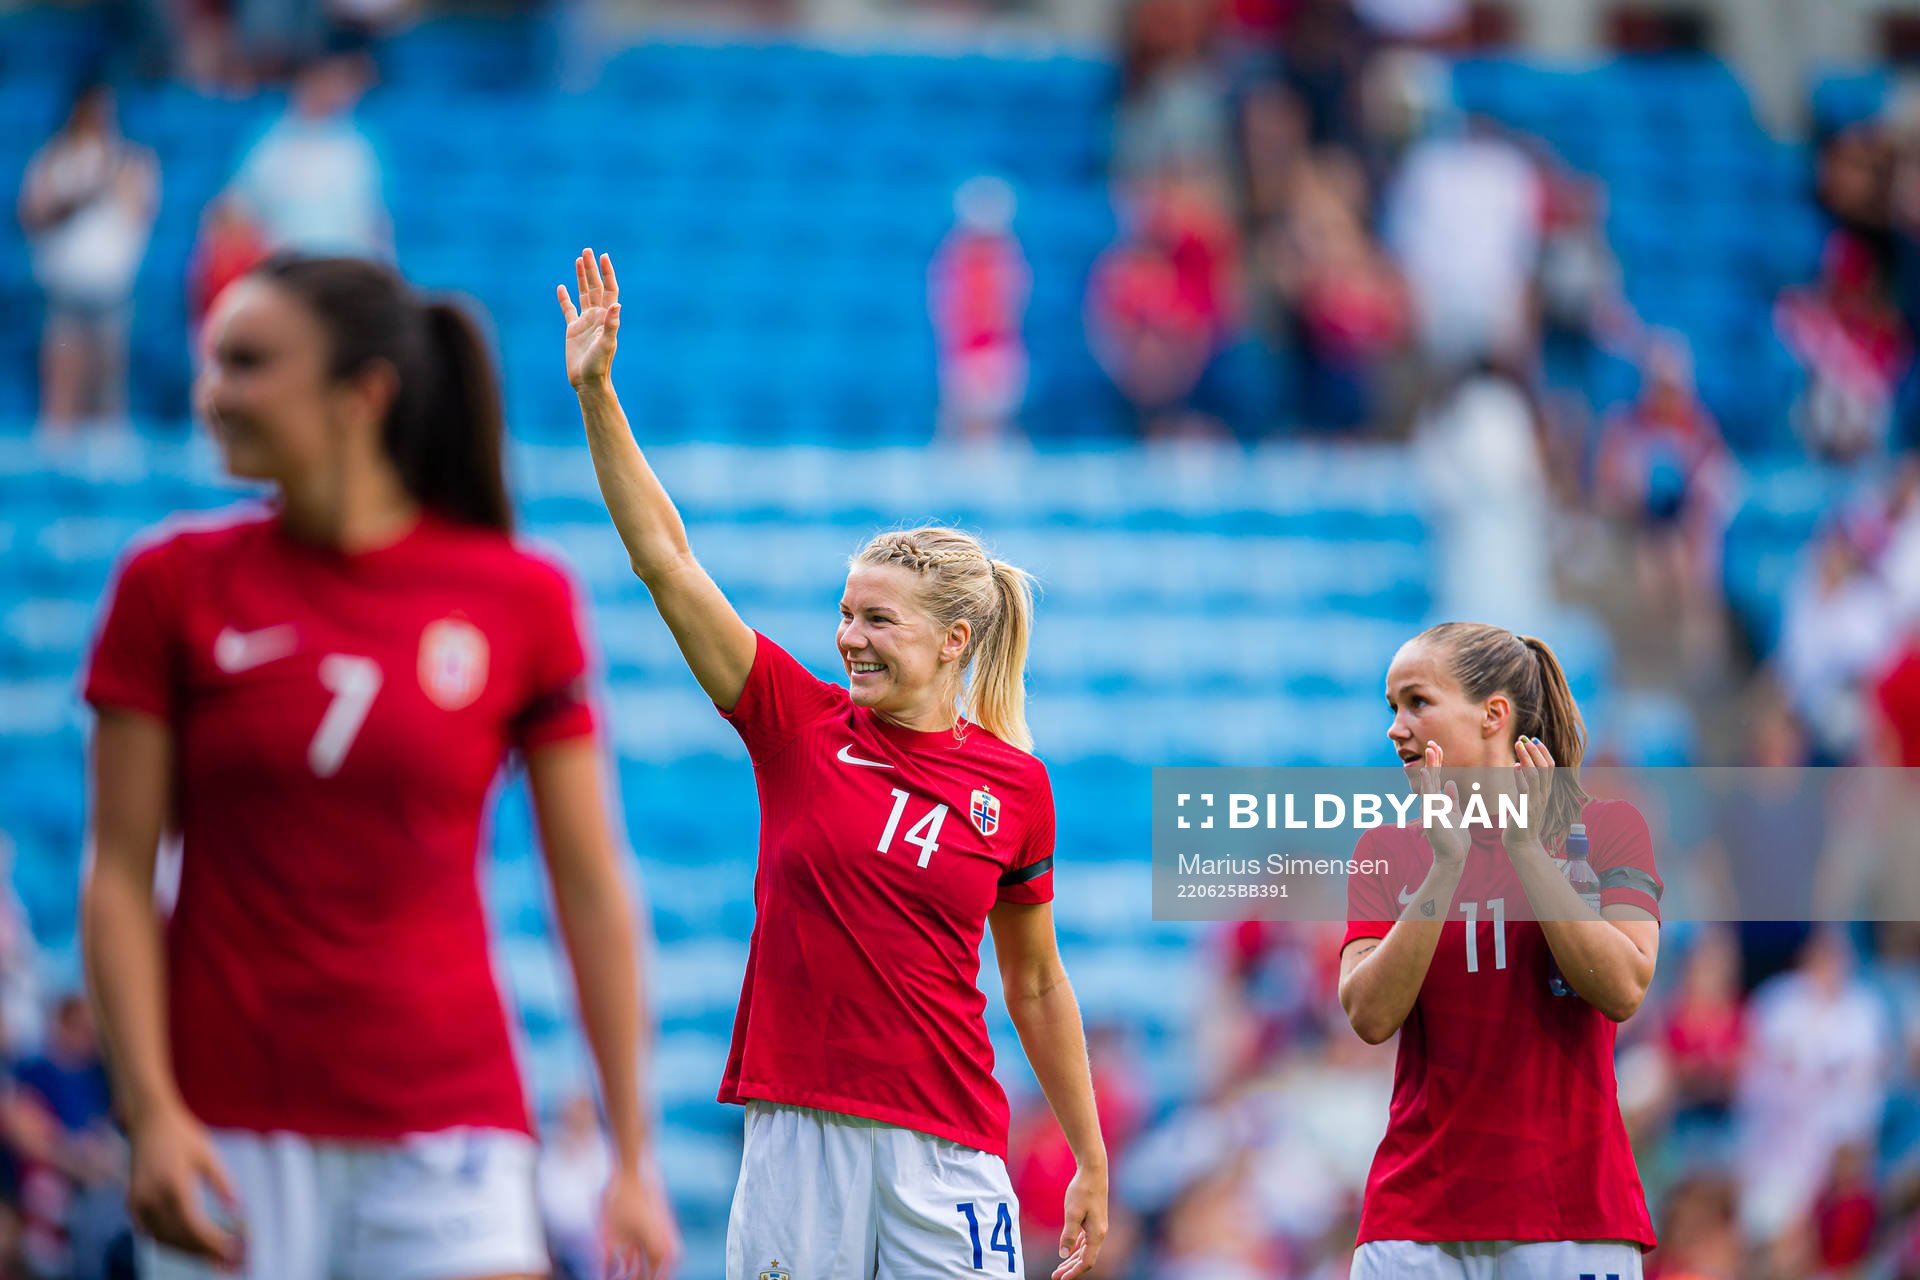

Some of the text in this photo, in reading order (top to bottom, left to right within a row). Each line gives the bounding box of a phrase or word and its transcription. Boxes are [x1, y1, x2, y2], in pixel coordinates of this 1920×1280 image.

[307, 652, 384, 779] 7
[877, 787, 949, 868] 14
[1459, 898, 1507, 973] 11
[956, 1202, 1016, 1273] 14
